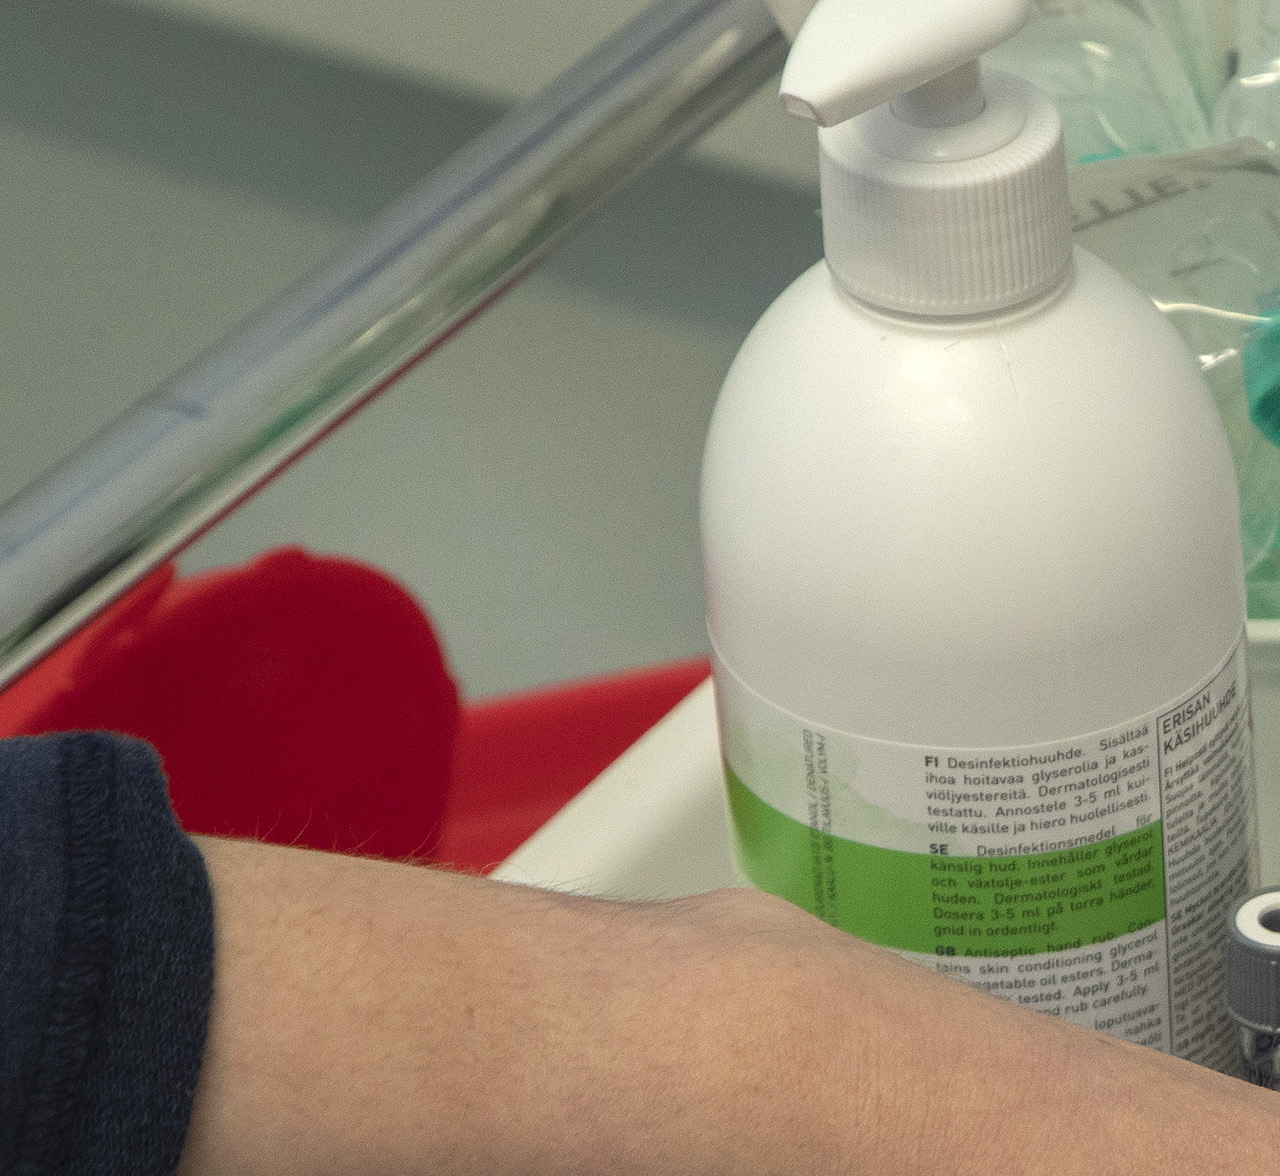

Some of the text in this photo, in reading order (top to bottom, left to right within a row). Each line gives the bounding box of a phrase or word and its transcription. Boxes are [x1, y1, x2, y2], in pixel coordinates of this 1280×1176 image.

[1162, 691, 1211, 735] ERISAN
[1164, 681, 1237, 755] KÄSIHUUHDE
[925, 725, 1149, 770] FI Desinfektiohuuhde. Sisältää
[925, 774, 956, 786] ihoa
[963, 774, 1024, 786] hoitavaa
[1031, 760, 1099, 785] glyserolia
[1105, 755, 1116, 769] ja
[1038, 757, 1150, 798] Dermatologisesti
[927, 806, 987, 819] testattu.
[995, 800, 1067, 818] Annostele
[1074, 792, 1098, 808] 3-5
[1103, 786, 1121, 801] ml
[928, 822, 957, 835] ville
[962, 820, 1009, 835] käsille
[1013, 820, 1026, 836] ja
[1030, 816, 1066, 831] hiero
[929, 843, 949, 856] SE
[976, 826, 1116, 858] Desinfektionsmedel
[930, 860, 983, 876] känslig
[1027, 849, 1099, 871] Innehåller
[931, 877, 957, 889] och
[1077, 863, 1105, 879] som
[994, 879, 1103, 905] Dermatologiskt
[933, 907, 984, 921] Dosera
[1021, 906, 1040, 919] ml
[1047, 903, 1064, 920] på
[1069, 896, 1104, 914] torra
[934, 922, 964, 939] gnid
[968, 922, 982, 936] in
[979, 963, 1009, 976] skin
[1017, 949, 1103, 975] conditioning
[1109, 929, 1159, 960] glycerol
[1046, 938, 1082, 953] hand
[966, 977, 1036, 993] egetable
[1039, 975, 1057, 988] oil
[1073, 980, 1111, 999] Apply
[1115, 970, 1139, 988] 3-5
[1143, 961, 1161, 977] ml
[1064, 1002, 1089, 1015] rub
